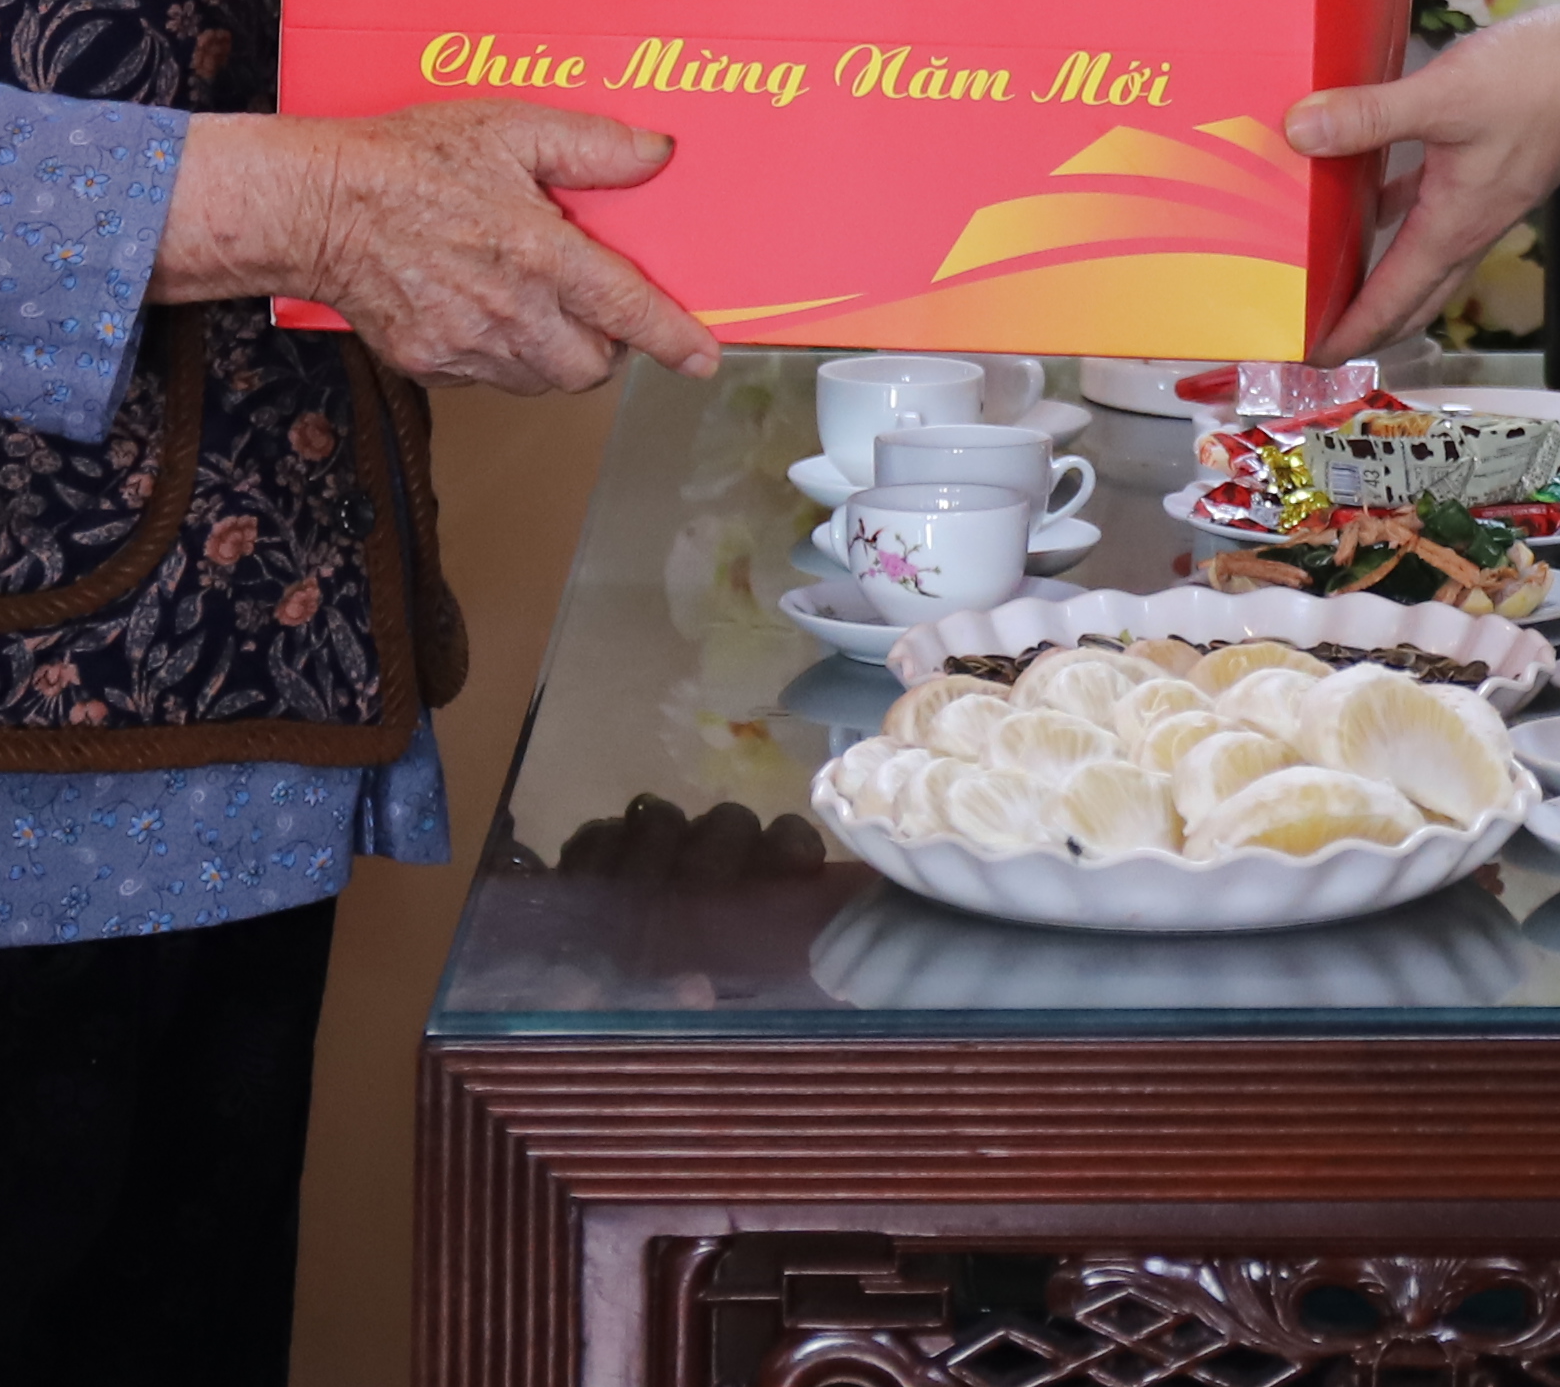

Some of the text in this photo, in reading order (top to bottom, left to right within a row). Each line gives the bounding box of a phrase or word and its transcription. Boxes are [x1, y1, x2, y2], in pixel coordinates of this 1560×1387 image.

[419, 31, 1171, 108] Chúc Mừng Năm Mới
